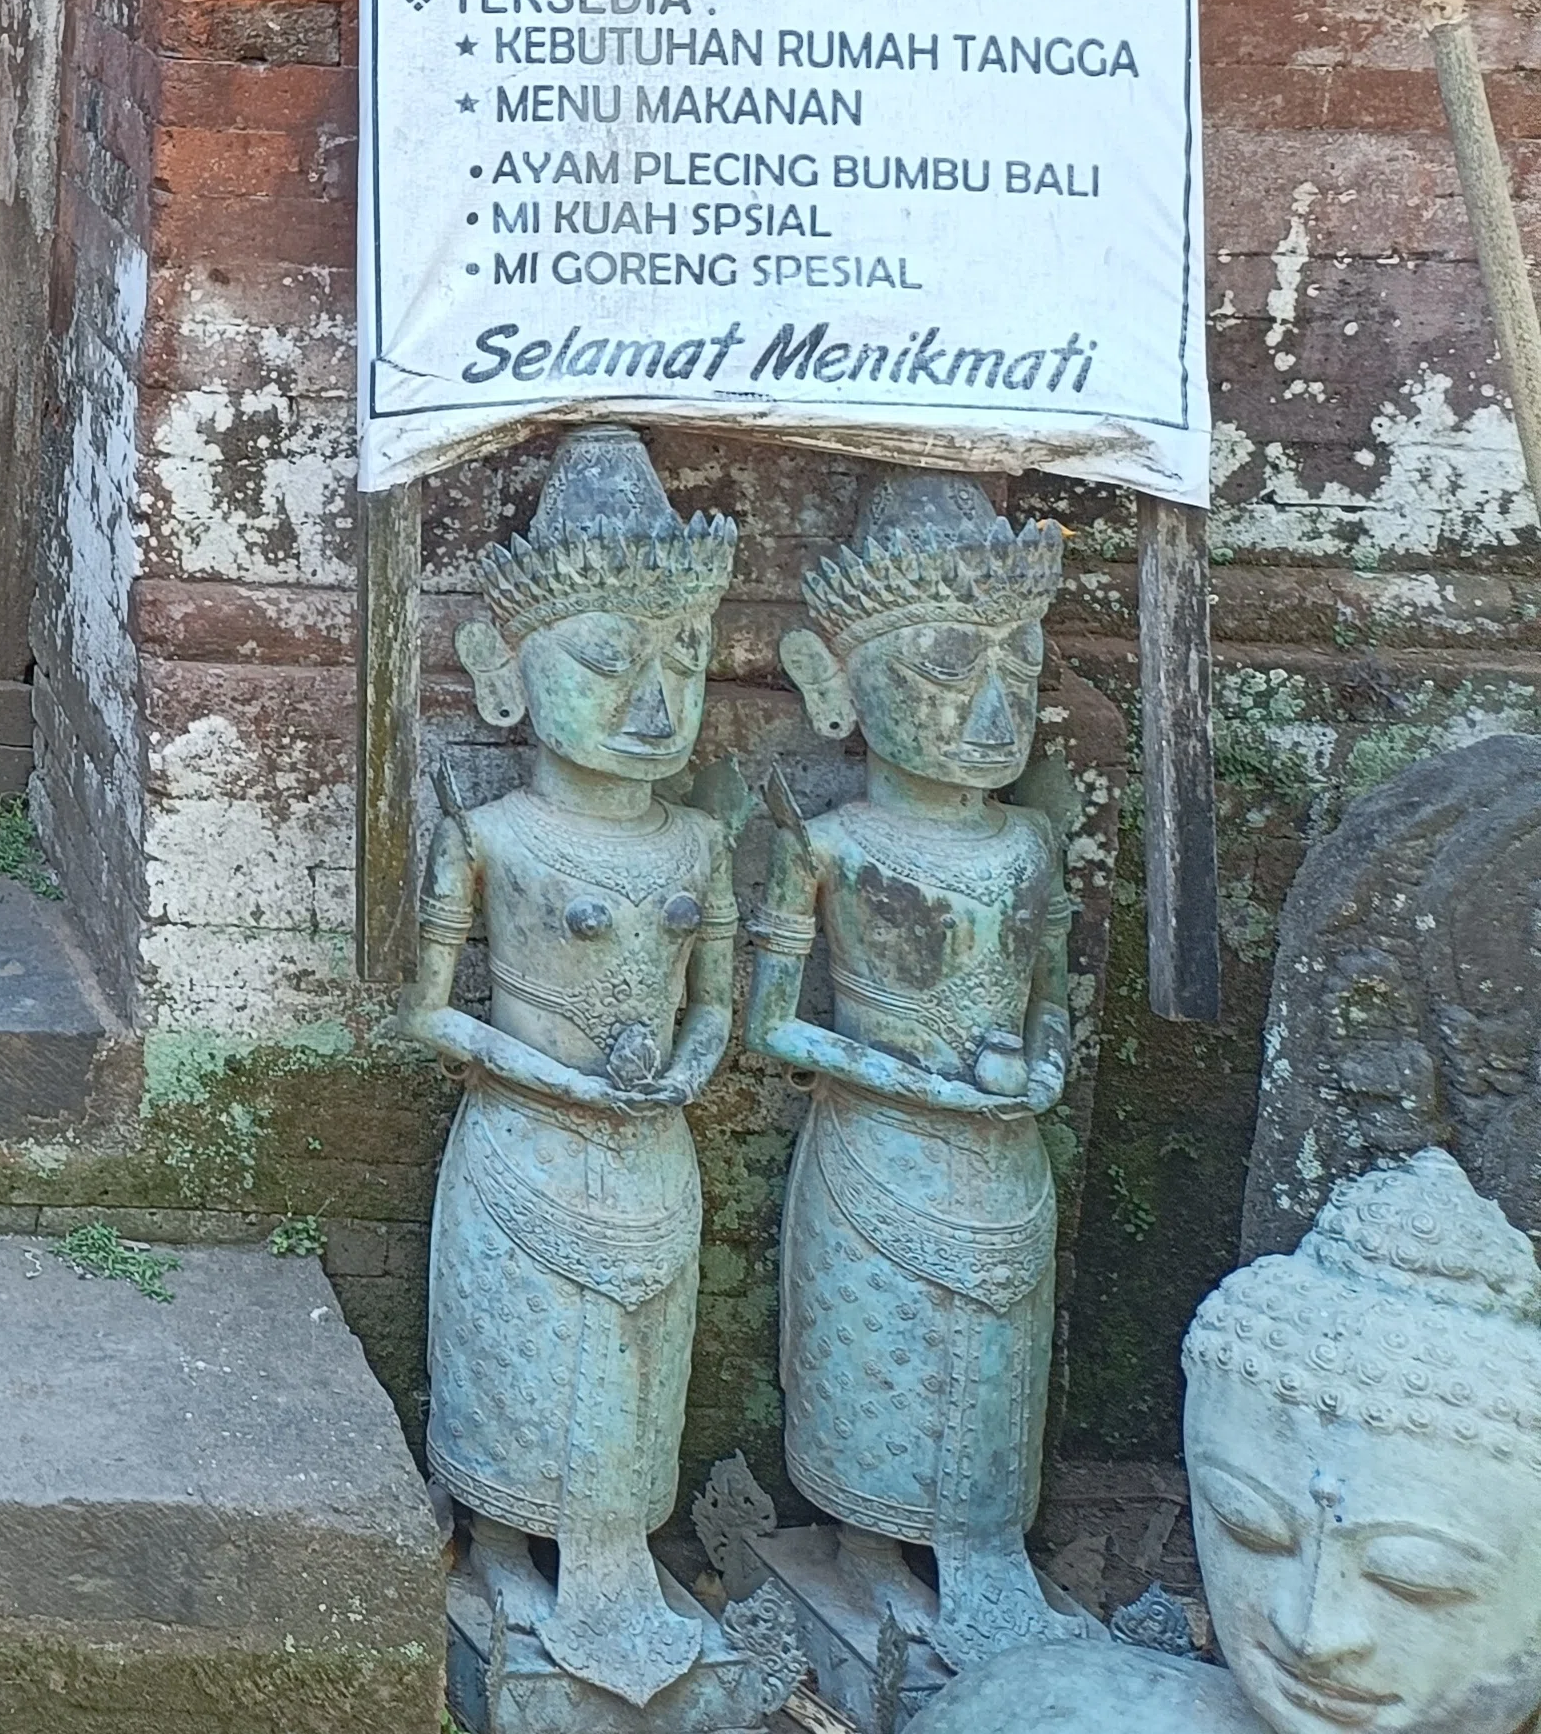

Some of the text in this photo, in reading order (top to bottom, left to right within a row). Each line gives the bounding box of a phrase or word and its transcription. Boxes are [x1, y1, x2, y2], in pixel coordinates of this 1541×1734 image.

[496, 27, 1140, 79] KEBUTUHAN RUMAH TANGGA
[497, 85, 862, 127] MENU MAKANAN
[492, 150, 1100, 198] AYAM PLECING BUMBU BALI
[493, 201, 833, 238] MI KUAH SPSIAL
[494, 251, 923, 290] MI GORENG SPESIAL
[462, 321, 1098, 394] Selamat Menikmati
